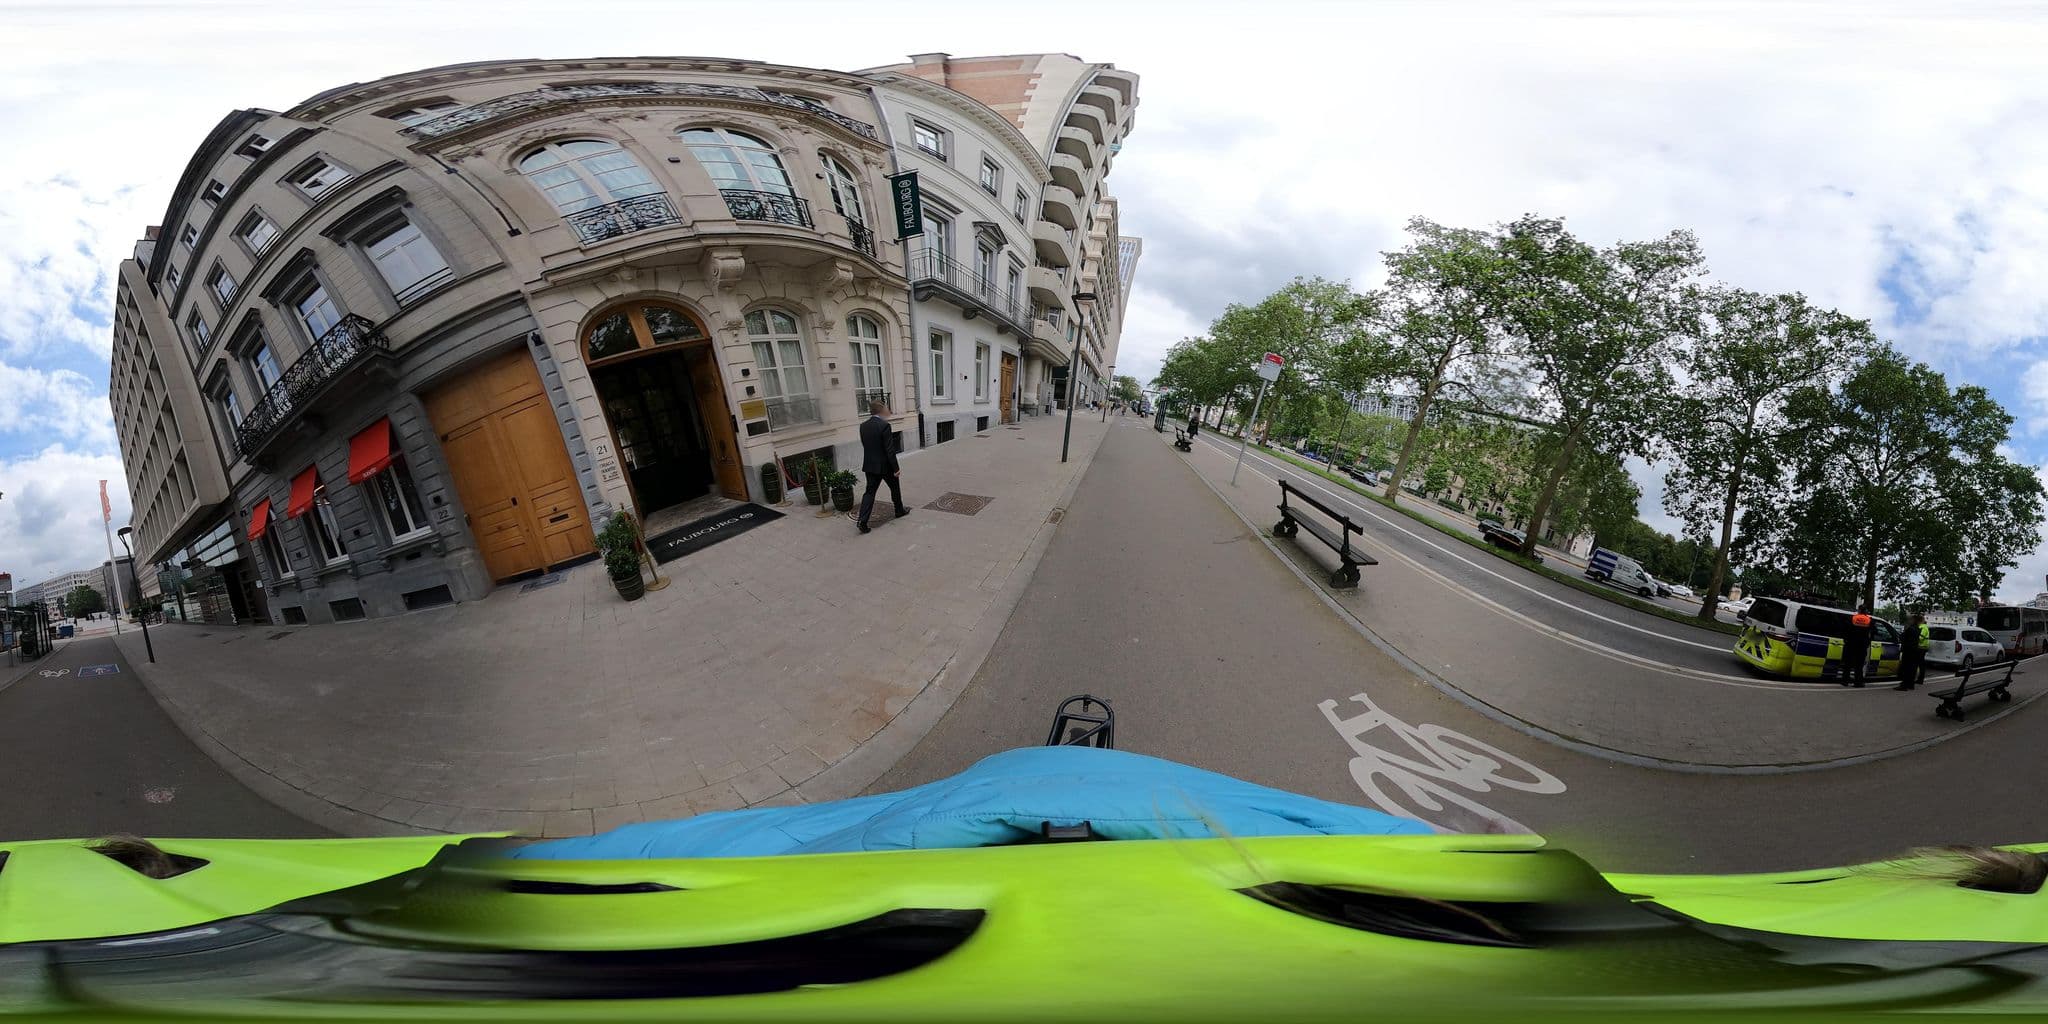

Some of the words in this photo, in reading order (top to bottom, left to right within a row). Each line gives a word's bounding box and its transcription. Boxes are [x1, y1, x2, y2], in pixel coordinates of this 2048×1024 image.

[901, 187, 915, 229] FAUBOURG
[597, 445, 608, 455] 21
[439, 510, 449, 519] 22
[668, 517, 740, 548] FAUBOURG
